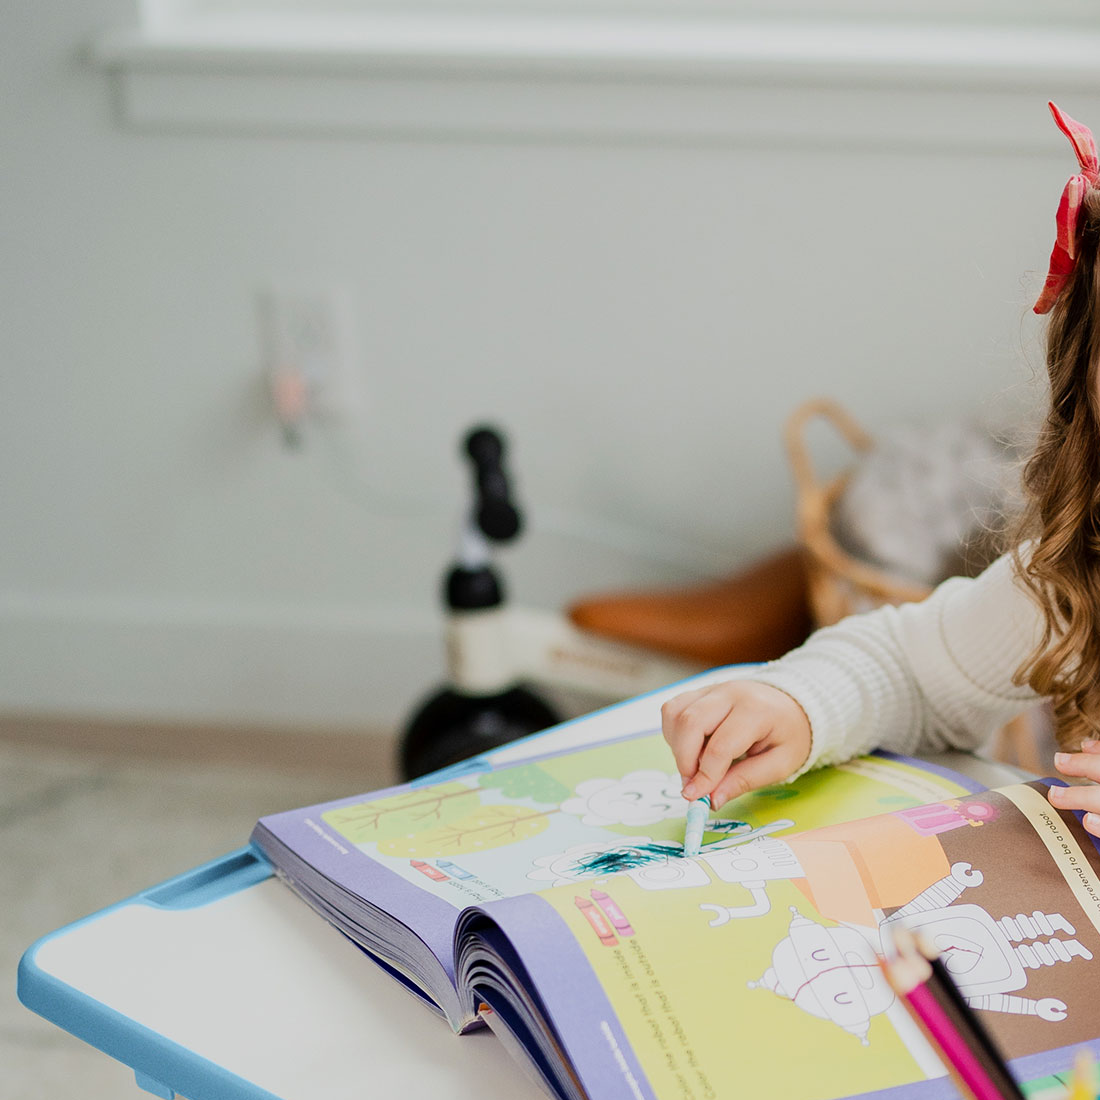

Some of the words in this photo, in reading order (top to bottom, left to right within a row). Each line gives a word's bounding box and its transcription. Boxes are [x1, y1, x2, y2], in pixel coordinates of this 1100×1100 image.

[1039, 811, 1059, 834] robot.
[1060, 843, 1071, 855] be
[1068, 856, 1078, 866] to
[1072, 867, 1100, 902] pretend
[613, 949, 634, 980] inside
[629, 939, 655, 977] outside
[634, 993, 653, 1016] that
[654, 990, 673, 1013] that
[647, 1018, 668, 1050] robot
[667, 1015, 689, 1047] robot
[664, 1052, 677, 1071] the
[684, 1049, 698, 1068] the
